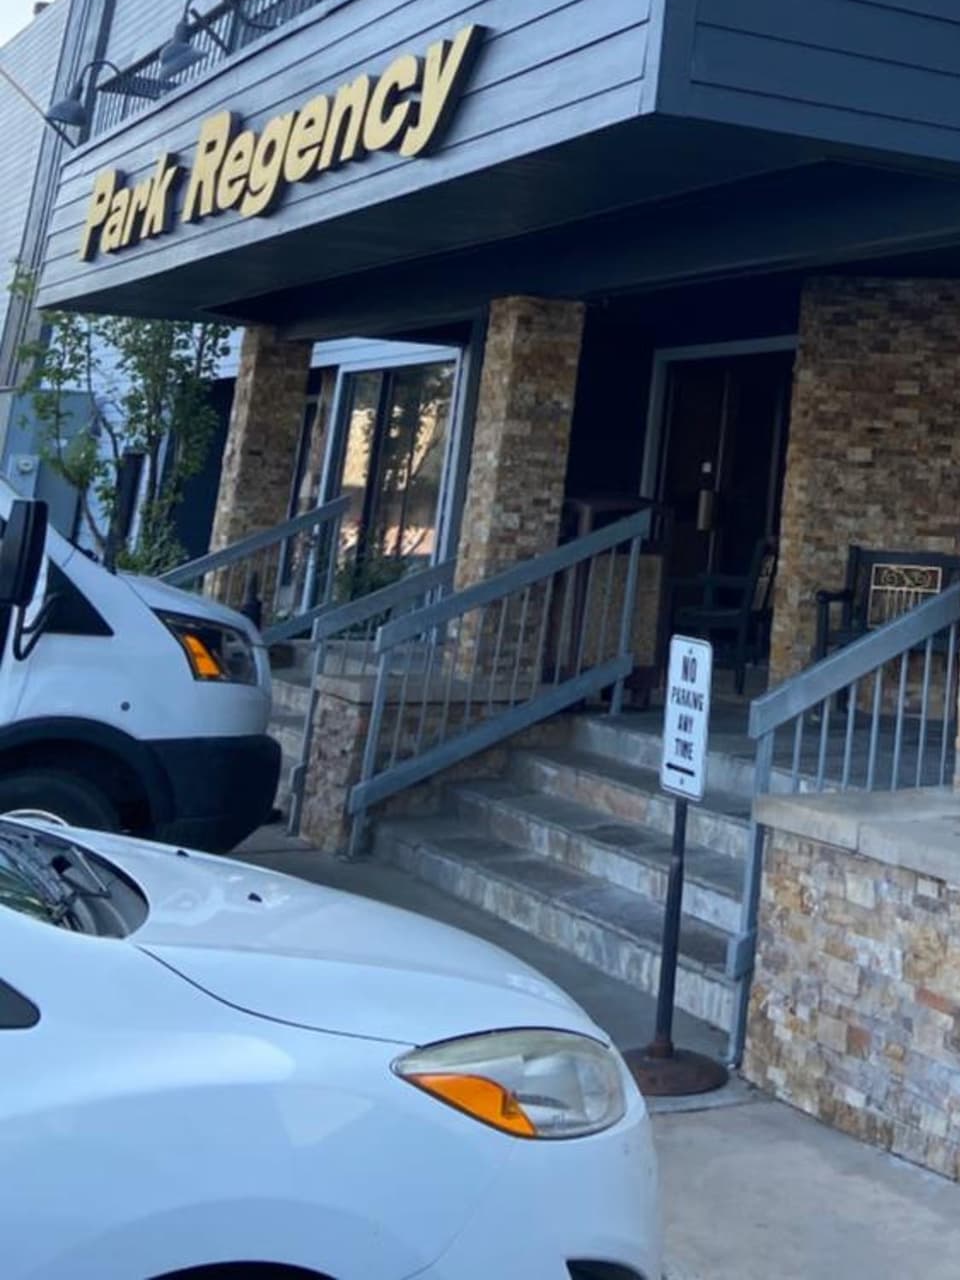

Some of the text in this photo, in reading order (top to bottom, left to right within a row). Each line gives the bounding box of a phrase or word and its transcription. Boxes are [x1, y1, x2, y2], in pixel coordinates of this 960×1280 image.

[80, 23, 484, 261] Park Regency
[682, 655, 698, 684] NO
[672, 686, 704, 712] PARKING
[677, 713, 694, 733] ANY
[675, 738, 694, 762] TIME
